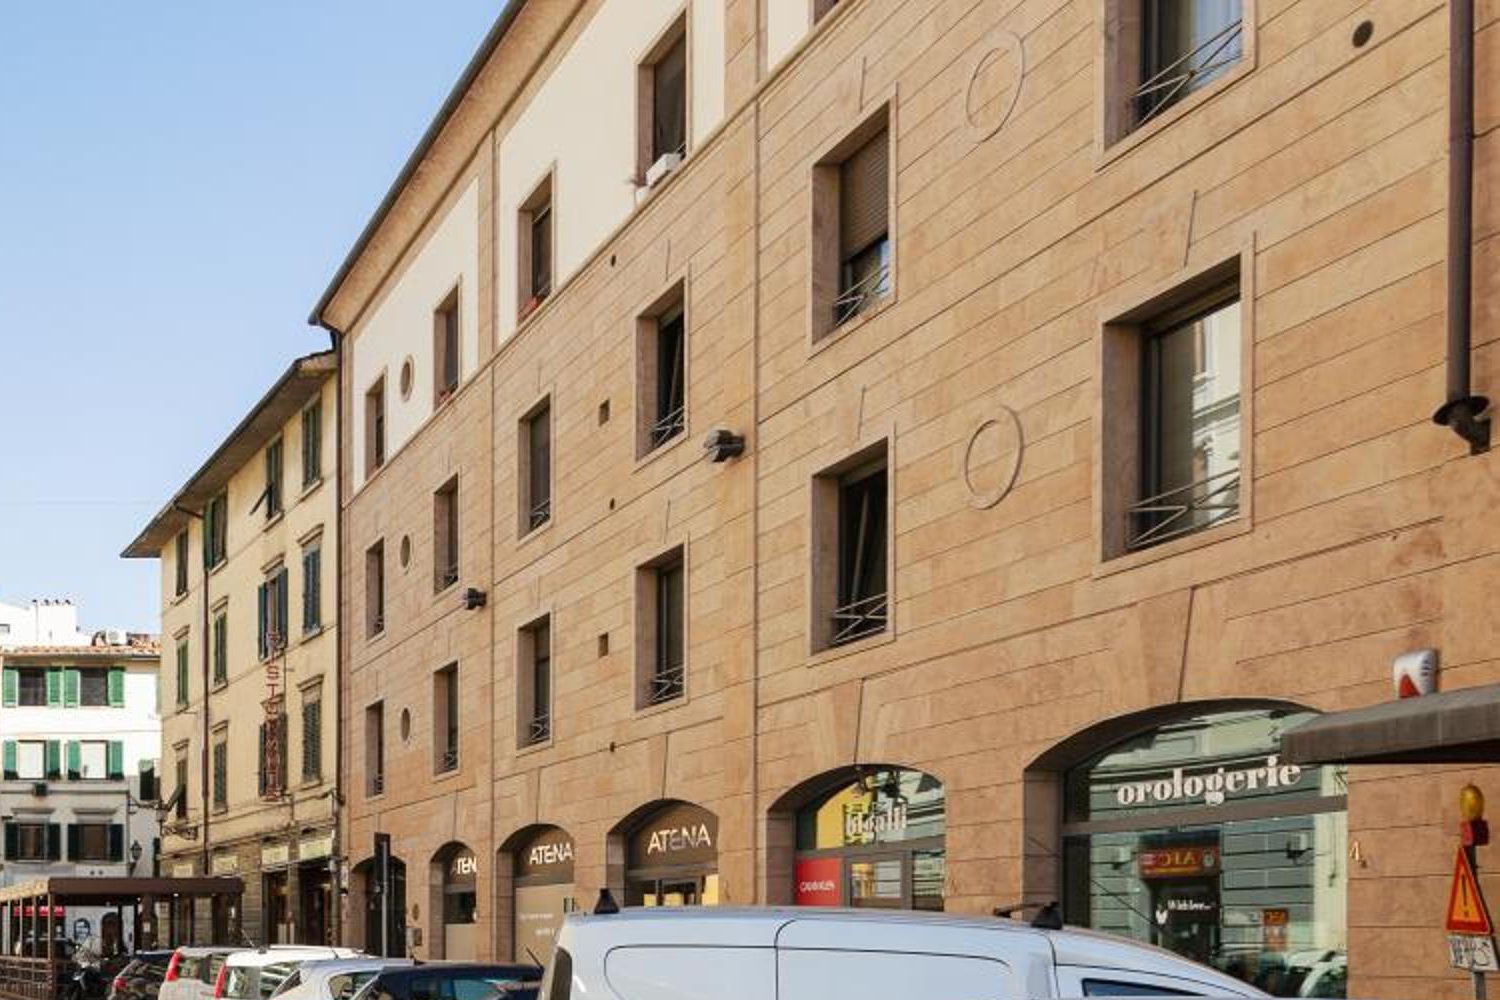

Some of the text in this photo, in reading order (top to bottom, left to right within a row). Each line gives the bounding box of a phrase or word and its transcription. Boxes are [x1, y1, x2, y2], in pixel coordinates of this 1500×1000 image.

[1116, 755, 1301, 807] orologerie
[529, 842, 573, 865] ATENA
[647, 823, 711, 855] ATENA
